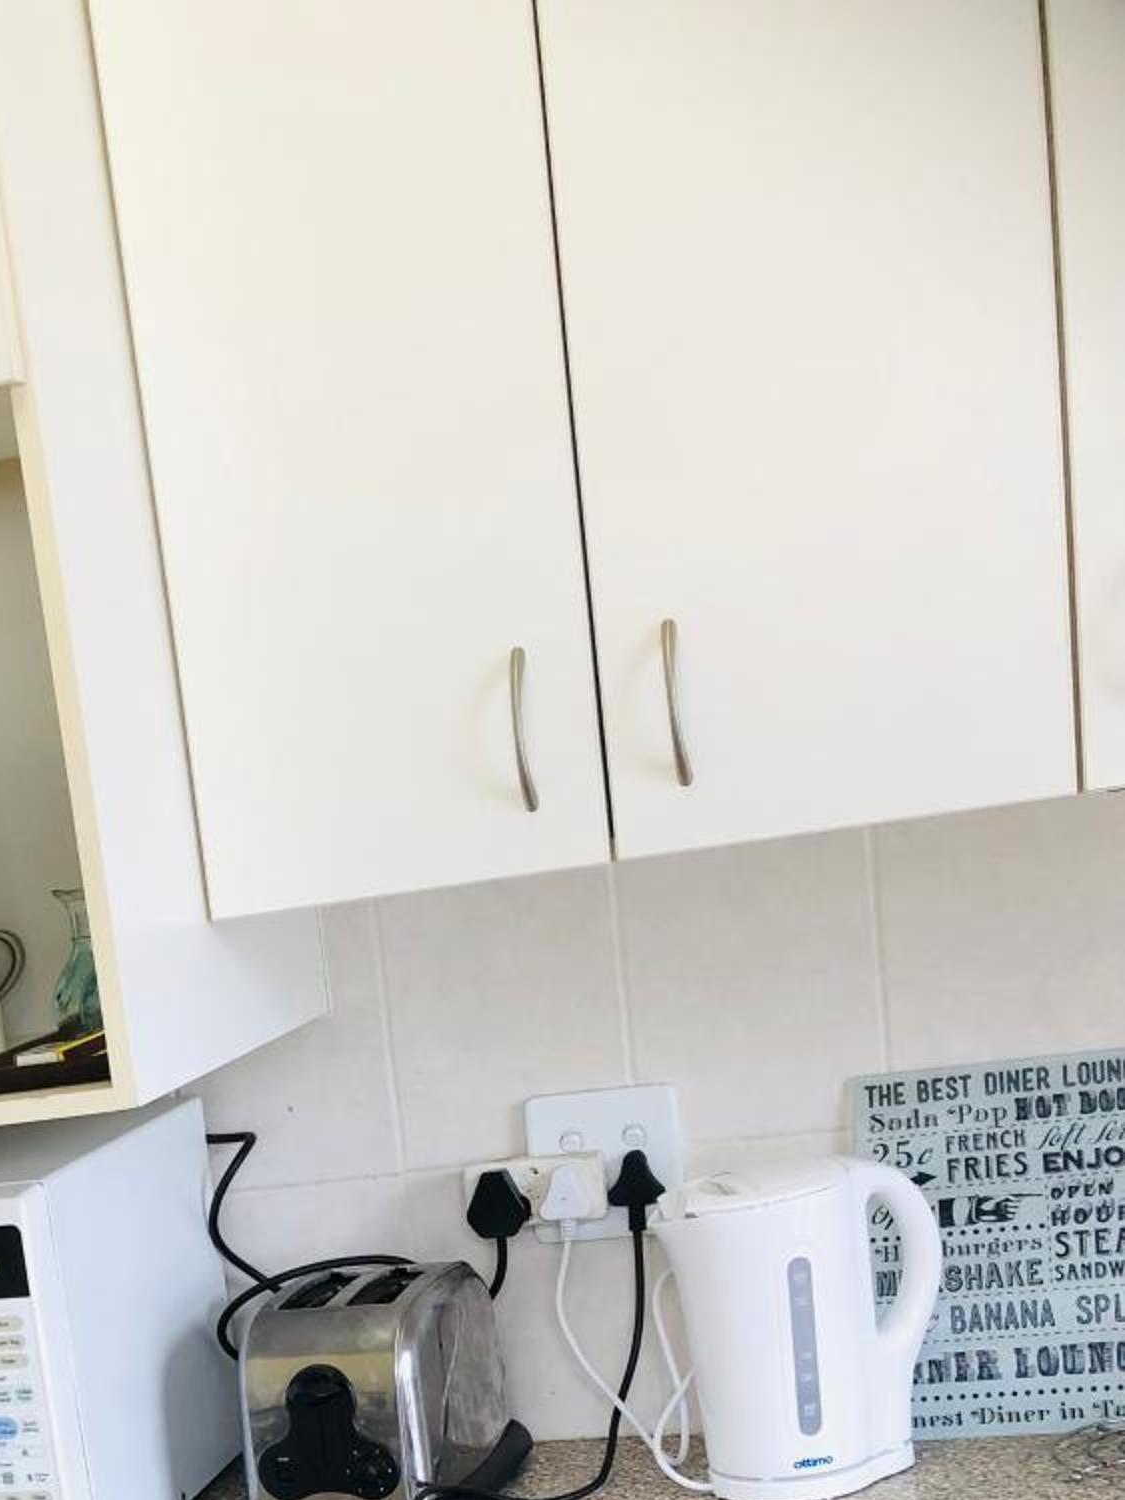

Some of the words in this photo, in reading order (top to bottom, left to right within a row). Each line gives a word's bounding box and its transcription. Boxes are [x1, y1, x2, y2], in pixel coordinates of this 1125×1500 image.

[864, 1082, 907, 1108] THE
[917, 1075, 972, 1103] BEST
[984, 1067, 1051, 1096] DINER
[1063, 1057, 1125, 1087] LOUN
[947, 1103, 1007, 1128] Pop
[1015, 1092, 1071, 1121] HOT
[946, 1129, 1025, 1154] FRENCH
[947, 1152, 1028, 1184] FRIES
[1050, 1178, 1114, 1200] OPEN
[950, 1298, 1056, 1335] BANANA
[970, 1404, 1050, 1426] Diner
[1059, 1401, 1084, 1420] in
